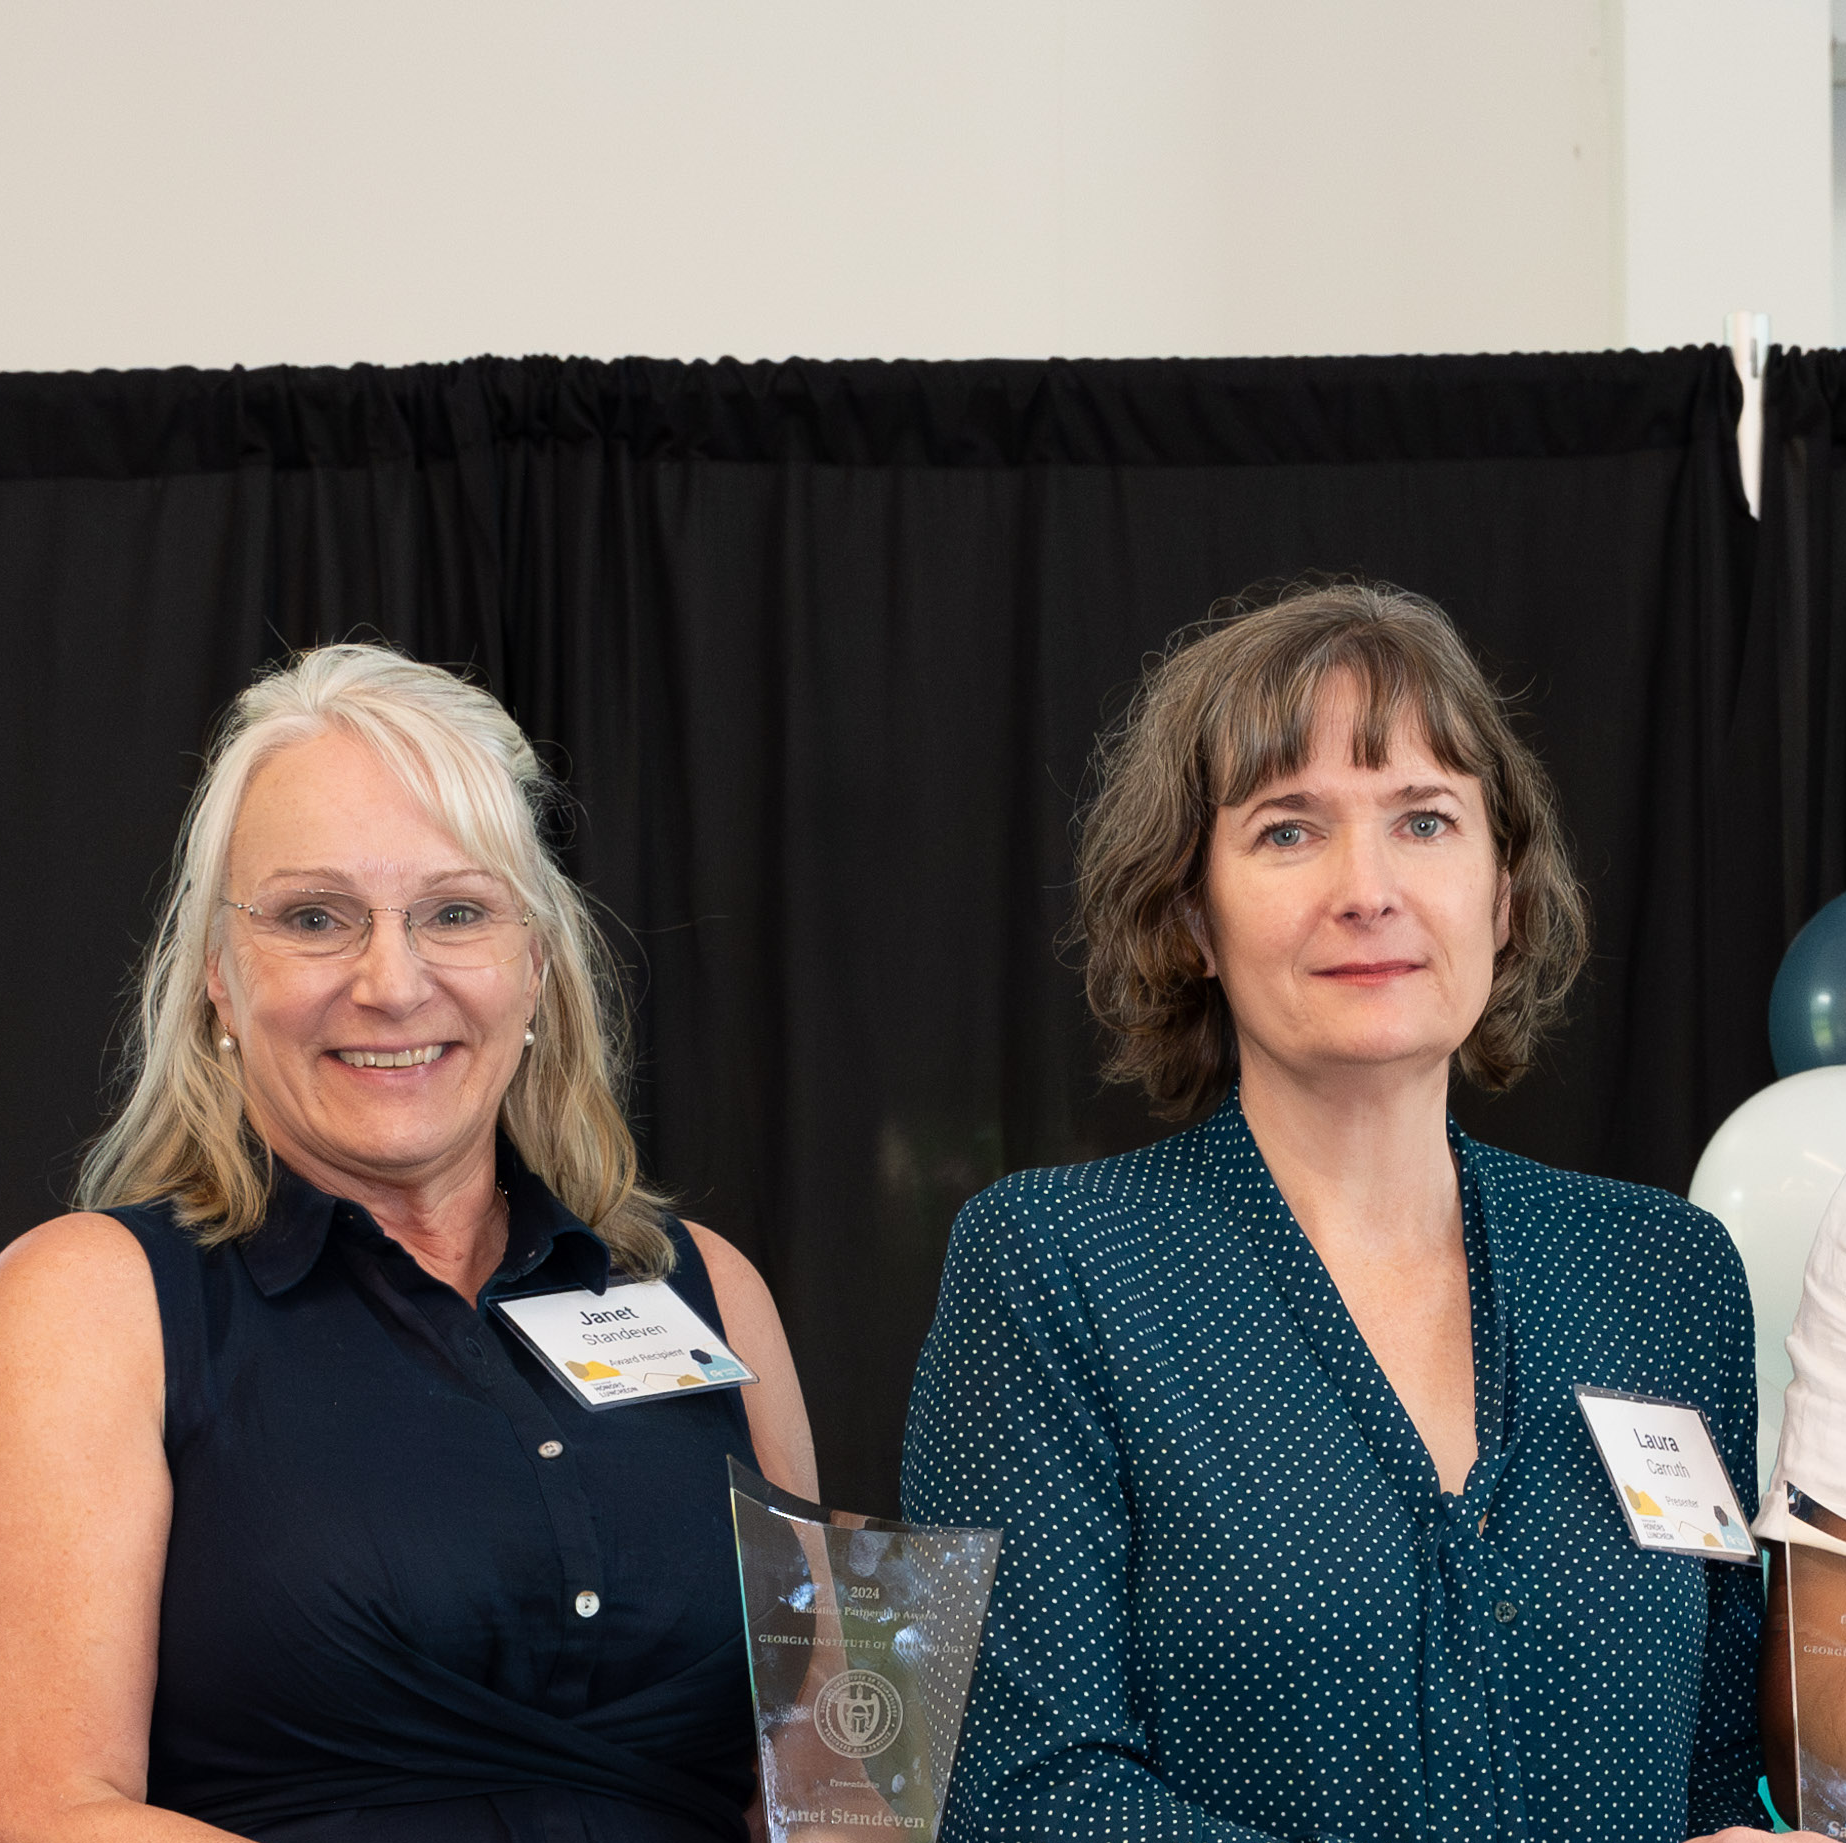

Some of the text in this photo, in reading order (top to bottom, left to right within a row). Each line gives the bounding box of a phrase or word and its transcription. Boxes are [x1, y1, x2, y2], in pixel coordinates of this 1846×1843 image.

[580, 1306, 640, 1326] Janet
[582, 1322, 668, 1346] Standeven
[610, 1348, 685, 1367] Award Recipient
[1633, 1428, 1680, 1452] Laura
[1646, 1458, 1691, 1479] Carruth
[850, 1586, 880, 1600] 2024
[758, 1634, 810, 1645] GEORGIA
[812, 1637, 870, 1649] INSTITUTE
[780, 1805, 925, 1829] Janet Standeven
